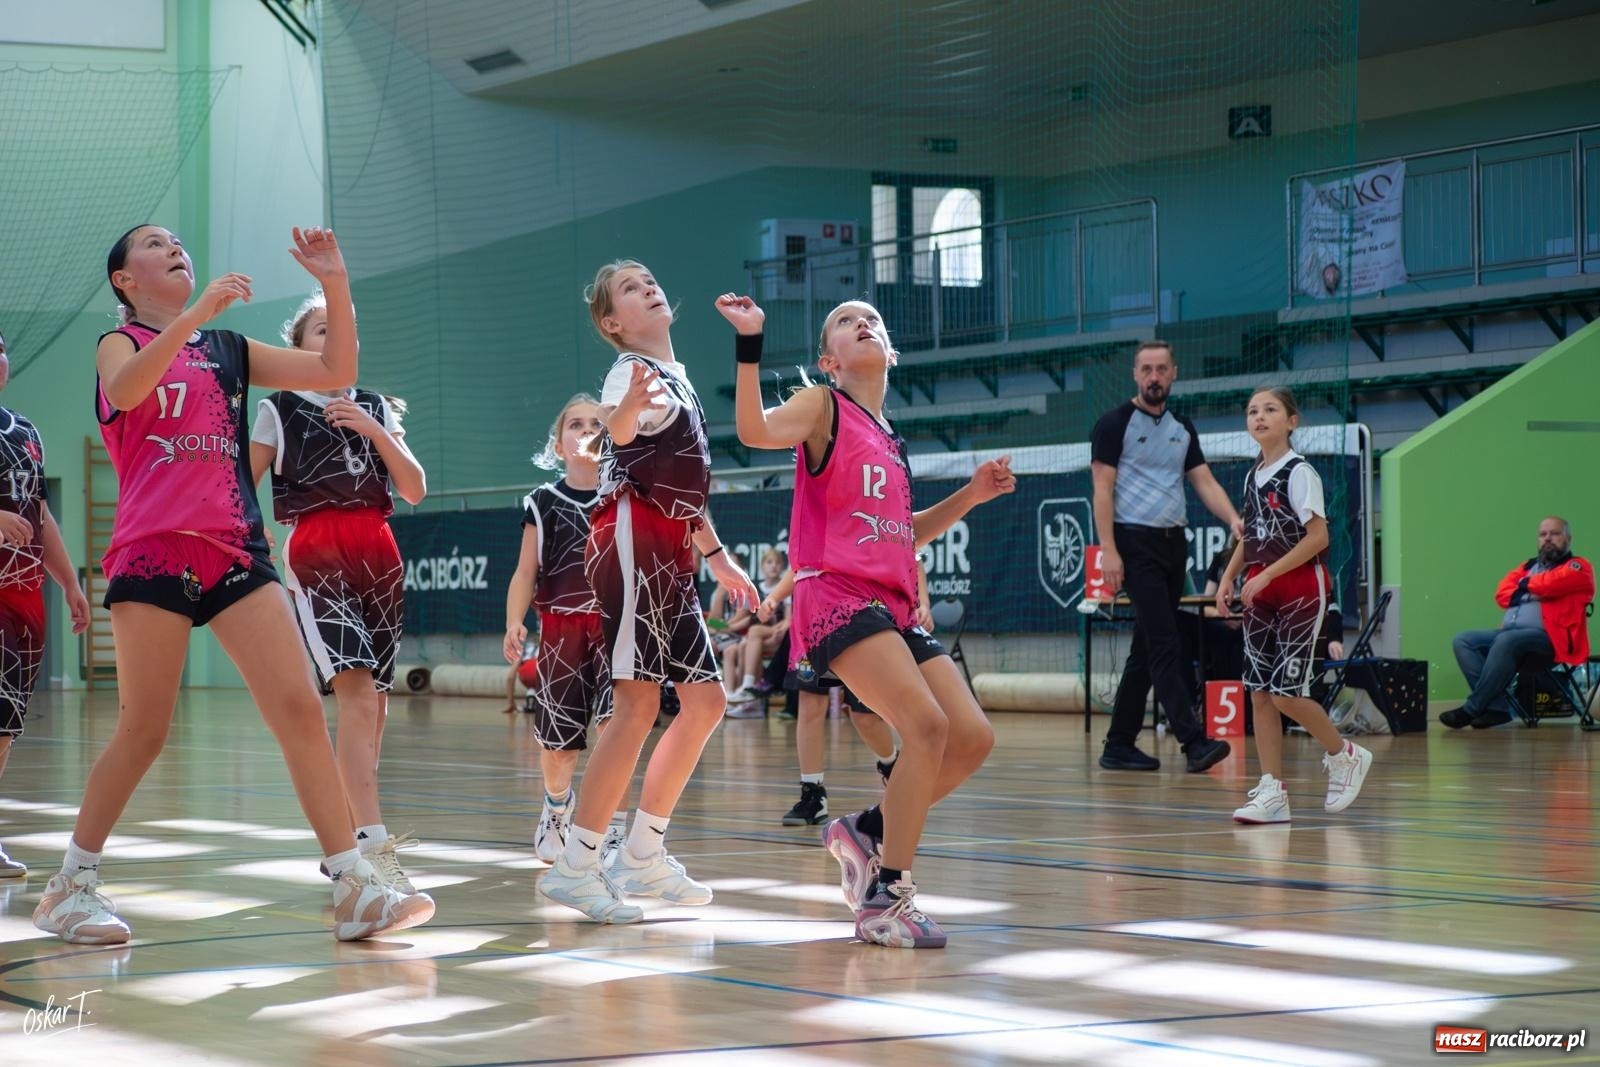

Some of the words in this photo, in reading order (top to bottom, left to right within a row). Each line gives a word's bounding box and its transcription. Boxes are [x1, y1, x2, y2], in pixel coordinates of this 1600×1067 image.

[1234, 116, 1264, 135] A
[155, 381, 188, 420] 17
[8, 468, 31, 501] 17
[861, 463, 887, 500] 12
[402, 545, 489, 592] ACIBÓRZ
[927, 575, 971, 596] ACIBÓRZ
[1287, 656, 1301, 679] 6
[1213, 686, 1239, 725] 5
